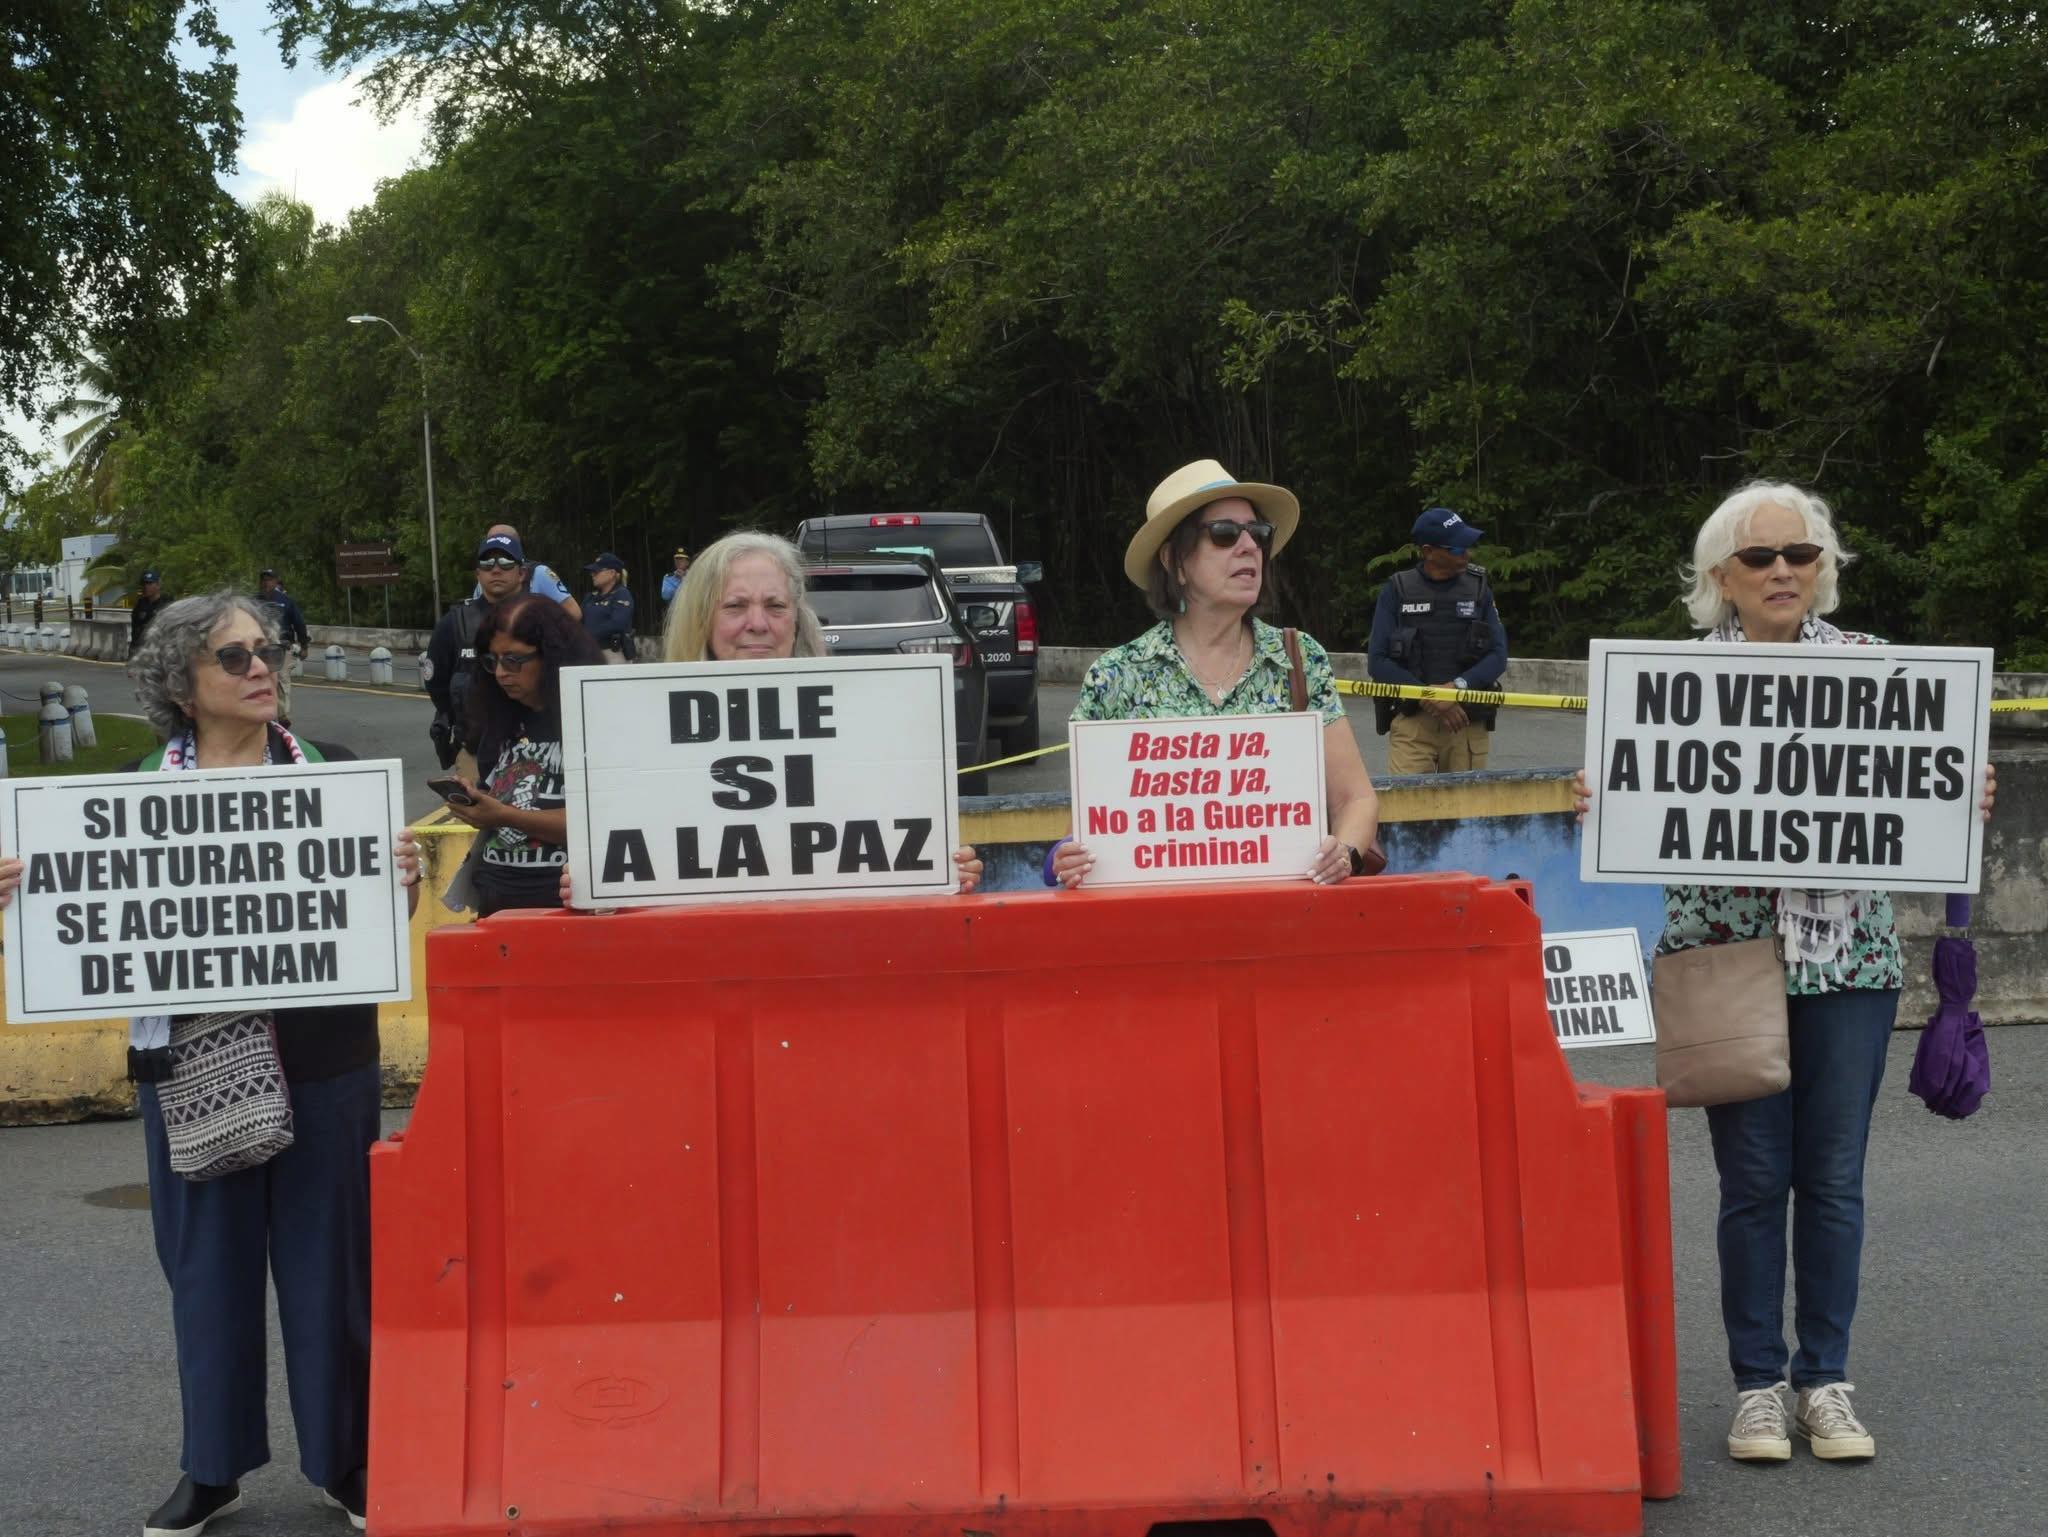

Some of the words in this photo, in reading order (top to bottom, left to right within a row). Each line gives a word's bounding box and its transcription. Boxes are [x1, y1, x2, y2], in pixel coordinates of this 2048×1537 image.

[669, 686, 837, 744] DILE
[1351, 682, 1400, 698] CAUTION
[1456, 690, 1505, 704] CAUTION
[1636, 672, 1703, 726] NO
[1716, 667, 1947, 731] VENDRÁN
[1128, 731, 1220, 762] Basta
[1227, 731, 1270, 760] ya,
[1608, 739, 1641, 792] A
[1654, 740, 1741, 794] LOS
[1753, 732, 1965, 801] JÓVENES
[710, 755, 815, 810] SI
[1130, 767, 1221, 798] basta
[1228, 767, 1270, 796] ya,
[84, 797, 127, 839] SI
[140, 788, 322, 841] QUIEREN
[1088, 806, 1129, 836] No
[1137, 808, 1156, 834] a
[1165, 803, 1195, 832] la
[1204, 800, 1312, 831] Guerra
[1659, 808, 1691, 860] A
[1702, 809, 1904, 865] ALISTAR
[28, 841, 285, 894] AVENTURAR
[298, 836, 381, 884] QUE
[602, 829, 656, 883] A
[676, 824, 769, 880] LA
[790, 818, 934, 876] PAZ
[1134, 834, 1269, 869] criminal
[57, 902, 109, 944] SE
[120, 889, 348, 942] ACUERDEN
[81, 953, 135, 996] DE
[144, 941, 338, 992] VIETNAM
[1544, 945, 1572, 973] O
